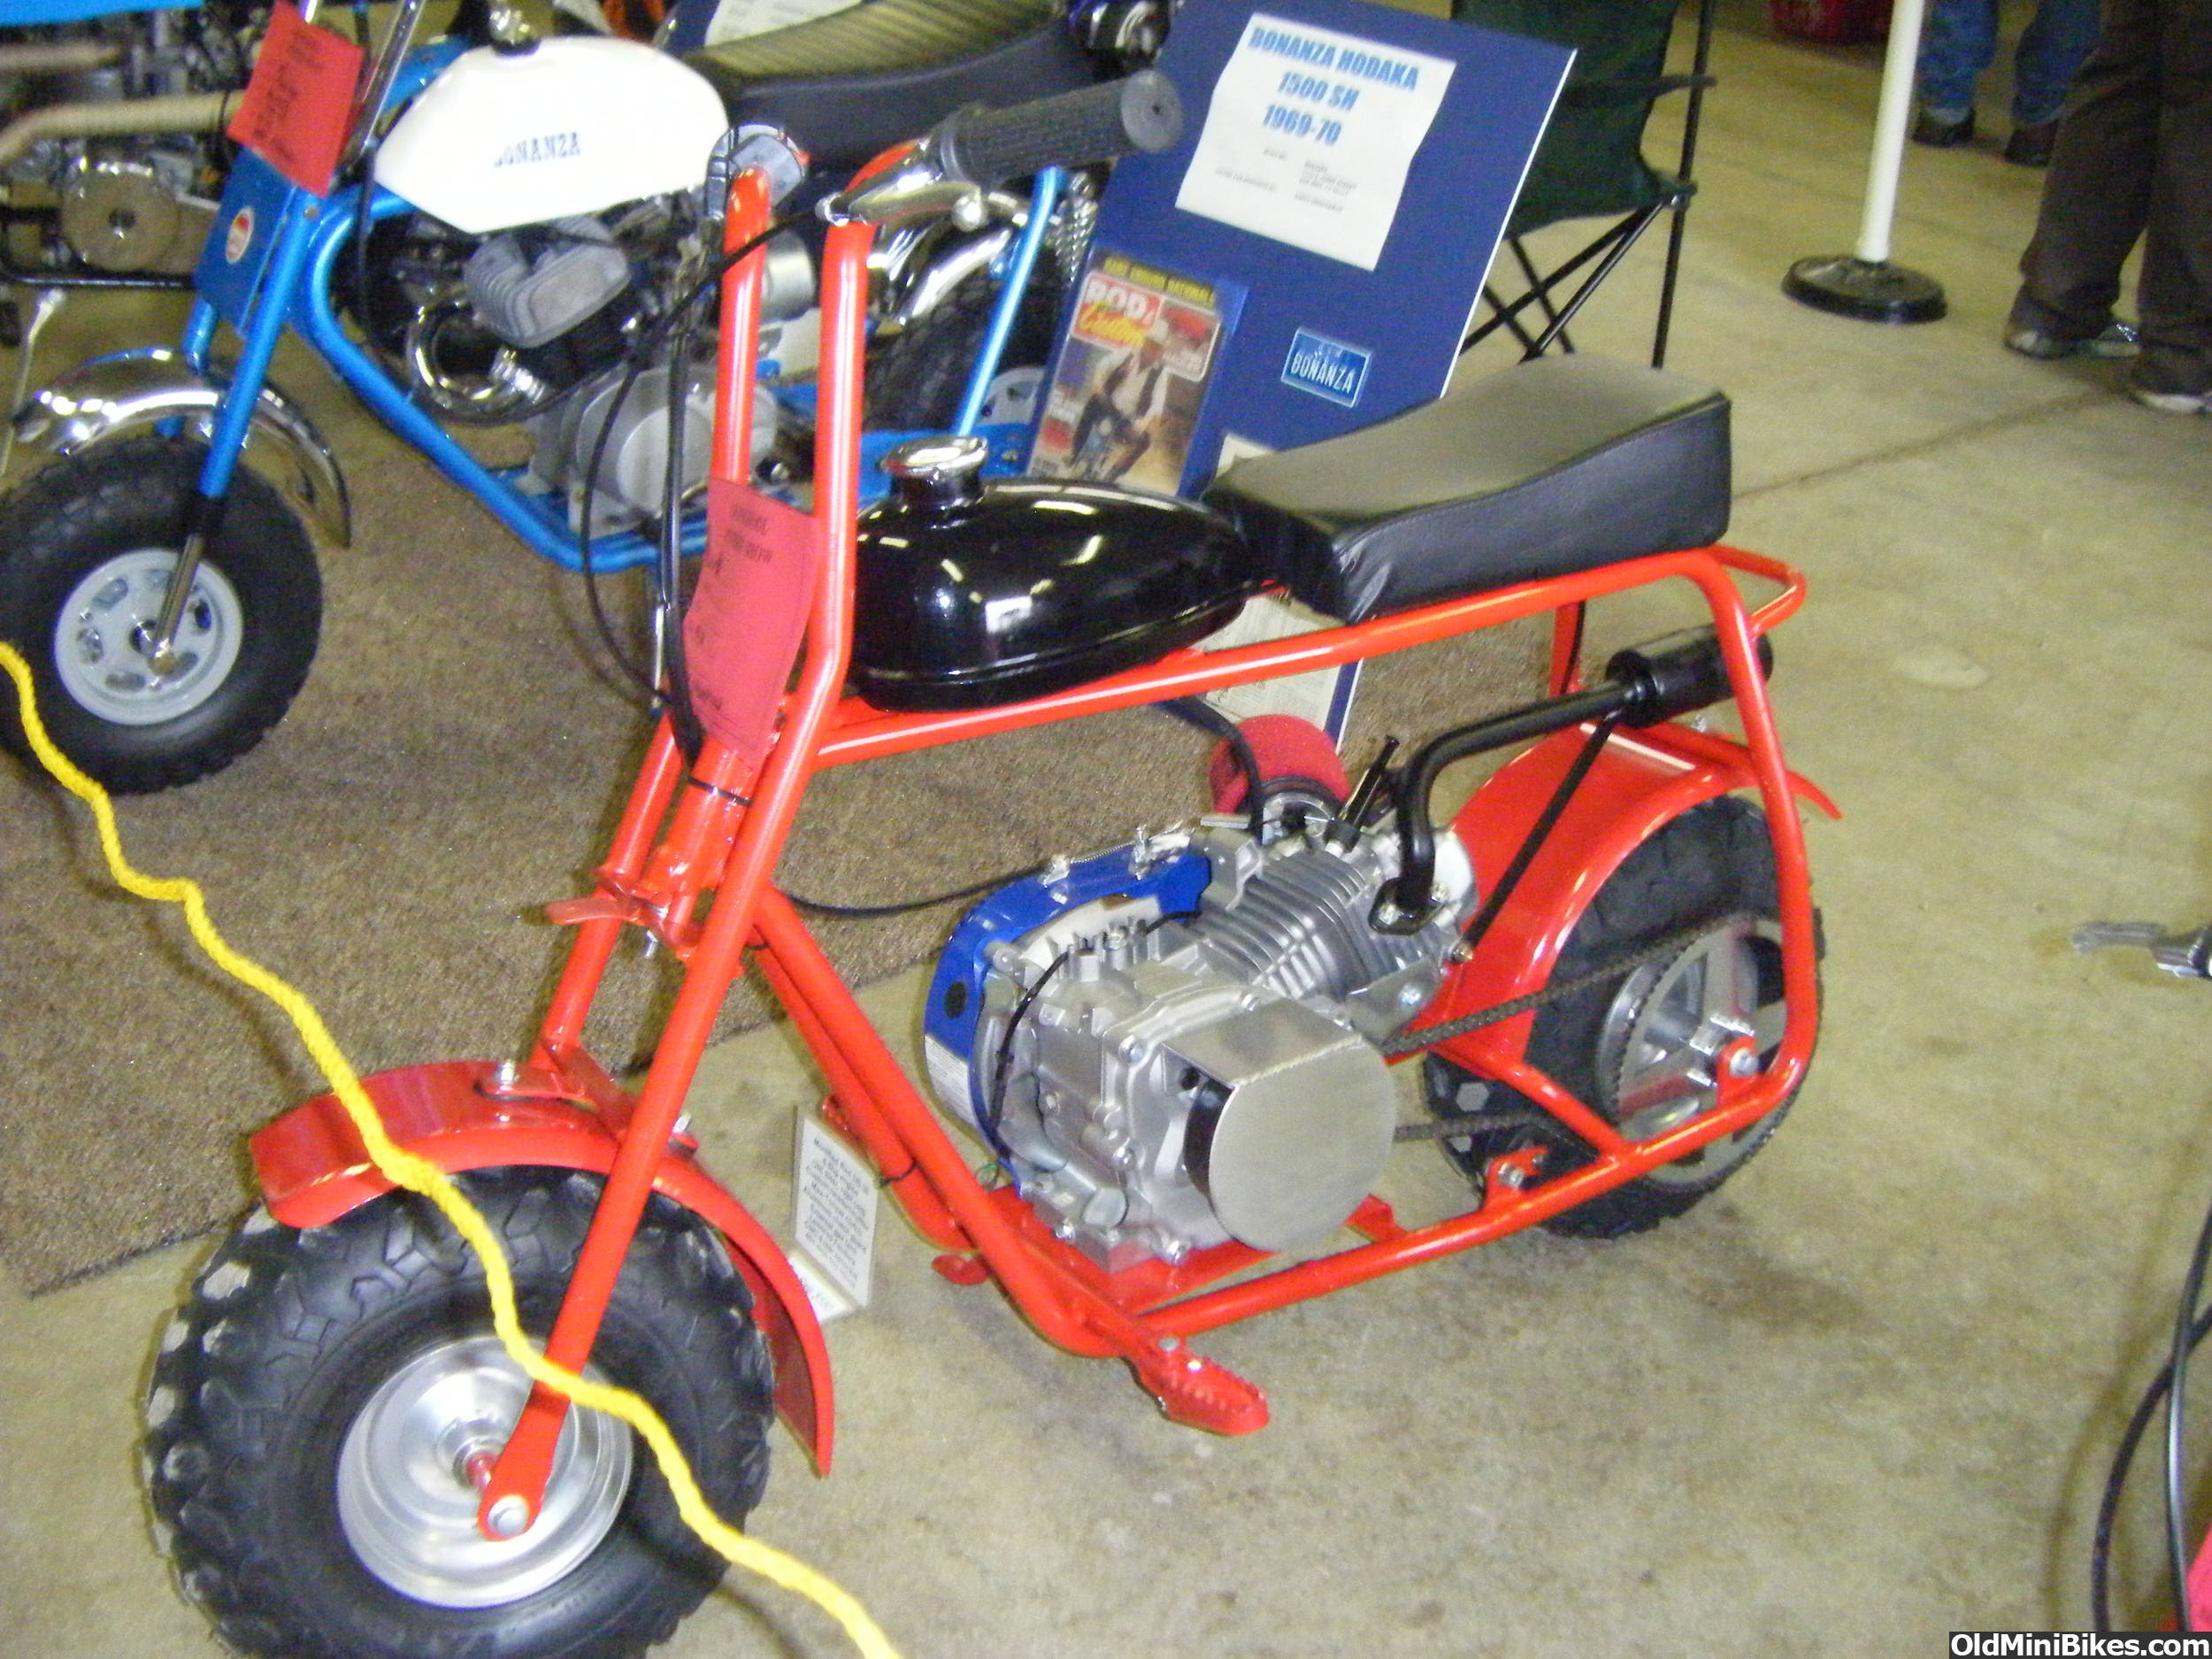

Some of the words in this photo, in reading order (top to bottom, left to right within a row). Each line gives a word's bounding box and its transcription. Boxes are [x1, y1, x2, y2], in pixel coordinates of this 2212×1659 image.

[1248, 27, 1336, 69] BONANZA
[1336, 48, 1420, 91] HODAKA
[1279, 71, 1328, 103] 1500
[1263, 104, 1342, 146] 1969-70
[493, 131, 581, 168] ONANZA
[1290, 349, 1356, 395] BONANZA
